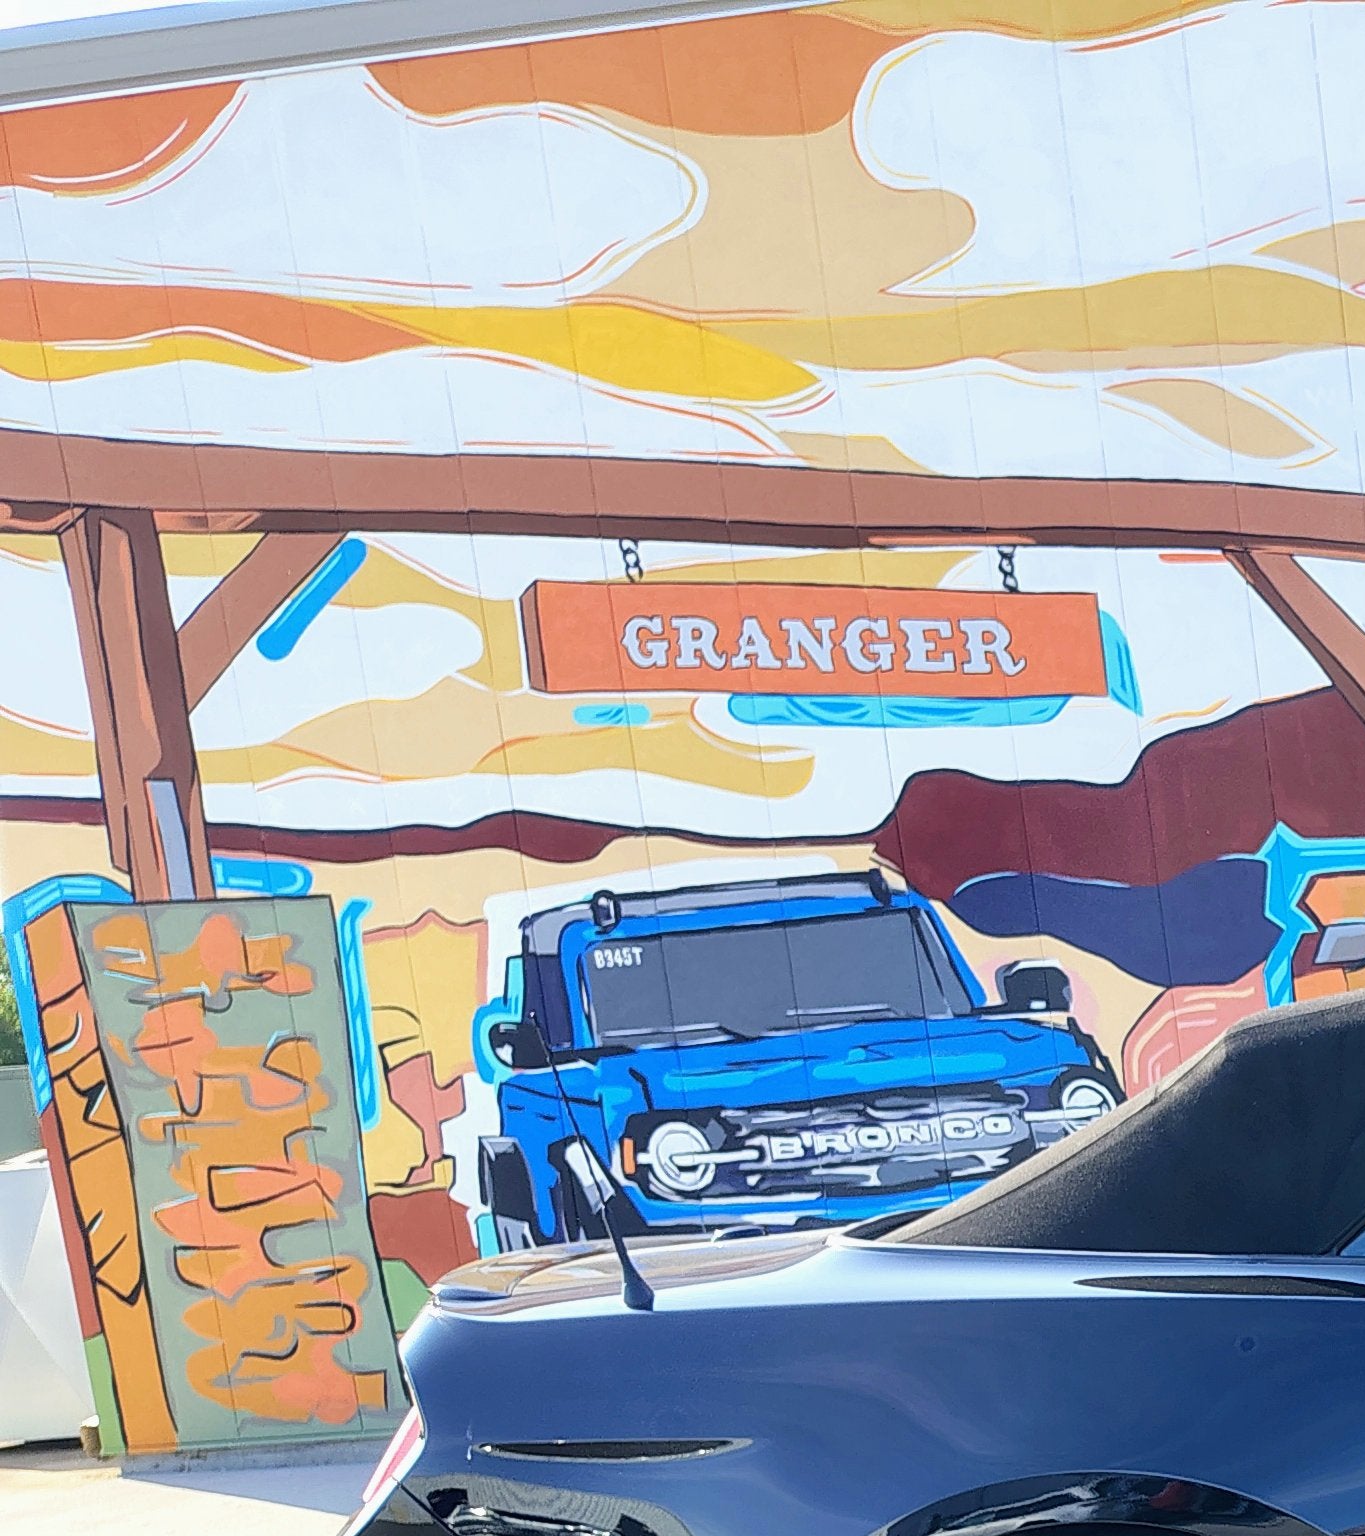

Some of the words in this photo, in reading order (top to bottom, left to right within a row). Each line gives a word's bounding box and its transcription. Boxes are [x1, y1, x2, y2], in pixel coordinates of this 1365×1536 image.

[621, 615, 1027, 677] GRANGER
[593, 946, 643, 969] B345T
[767, 1112, 1014, 1161] BRONCO
